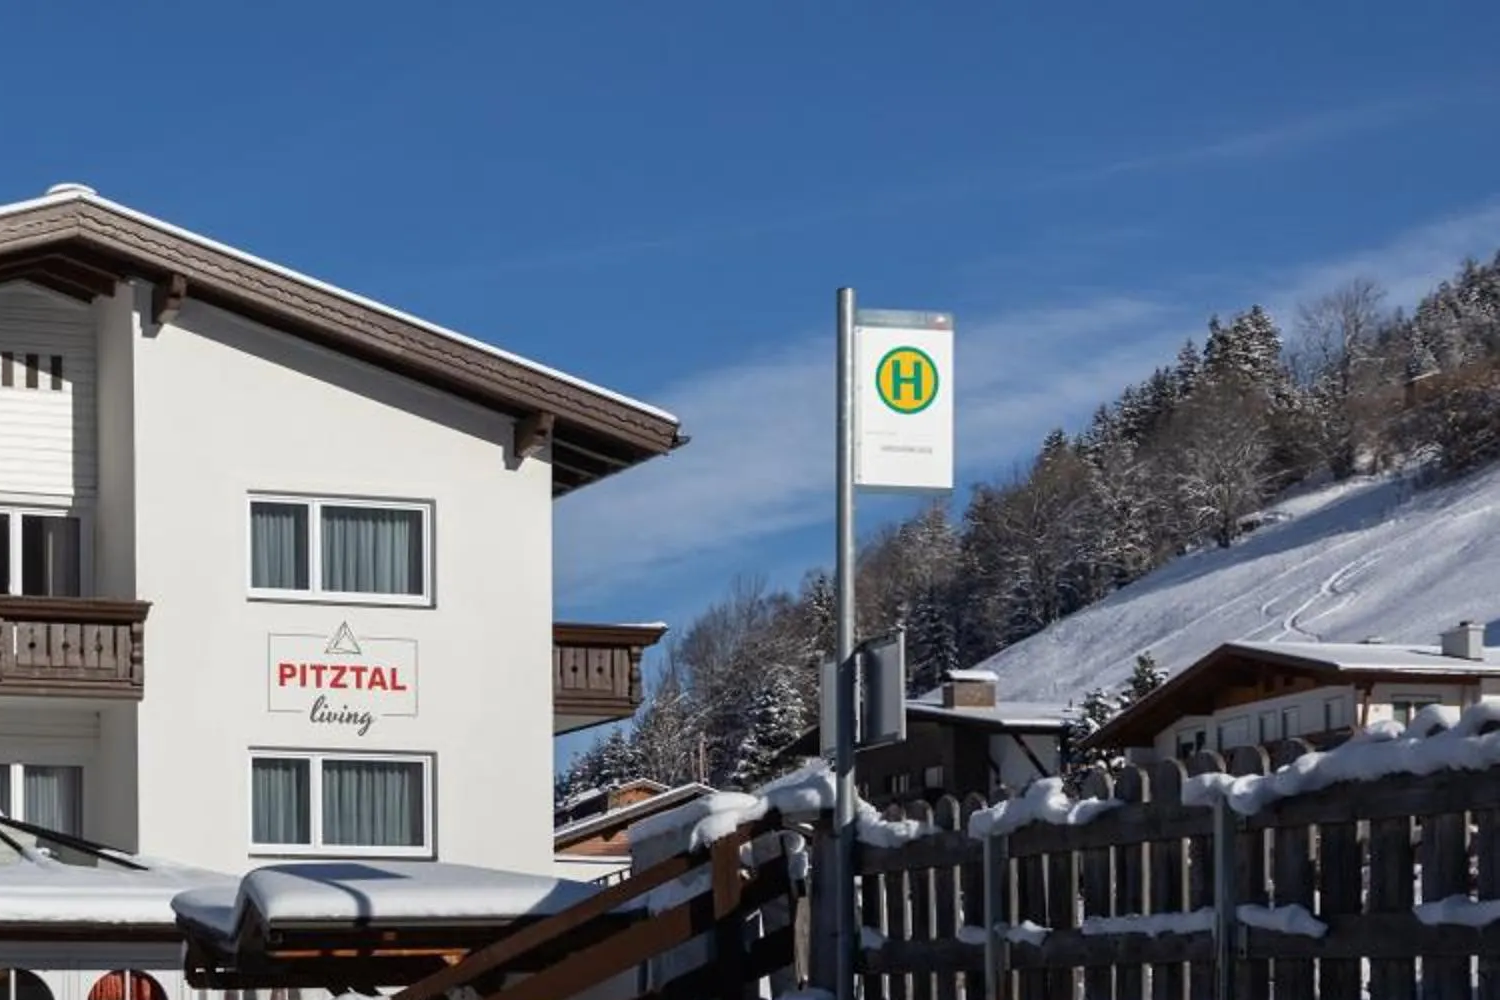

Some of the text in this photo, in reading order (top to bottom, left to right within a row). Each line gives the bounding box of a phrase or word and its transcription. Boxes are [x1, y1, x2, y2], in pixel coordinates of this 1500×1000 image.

[892, 359, 922, 401] H
[278, 663, 407, 691] PITZTAL
[309, 694, 374, 737] living
